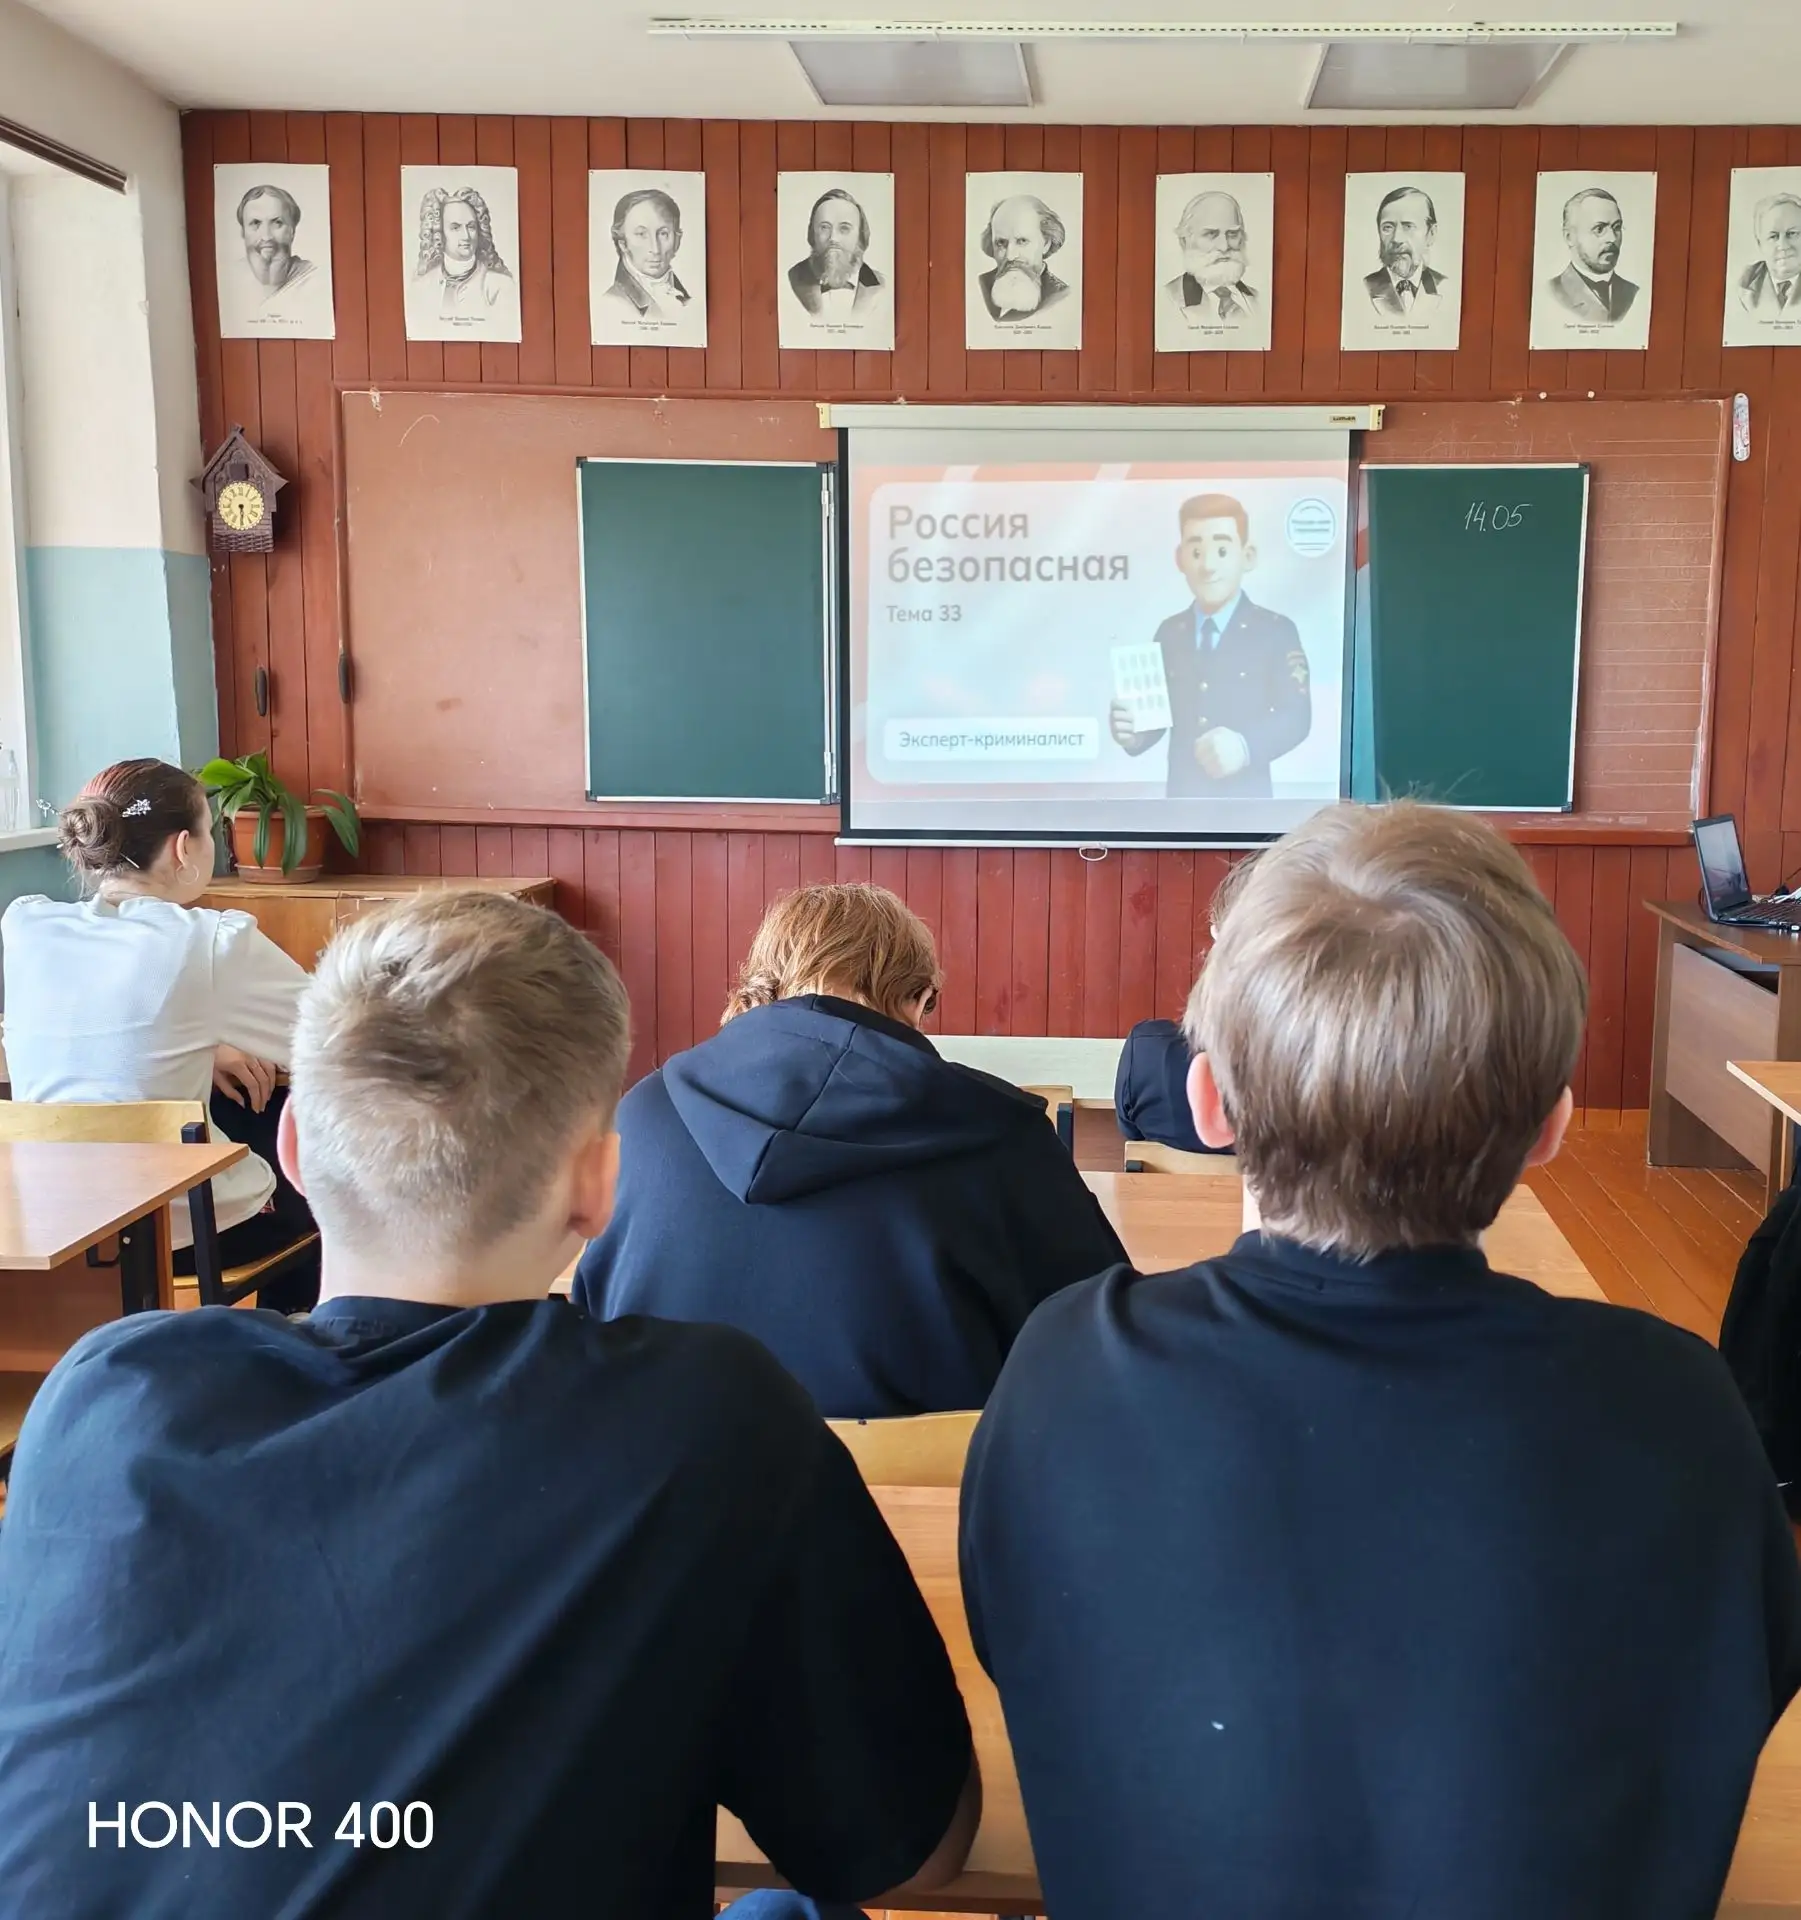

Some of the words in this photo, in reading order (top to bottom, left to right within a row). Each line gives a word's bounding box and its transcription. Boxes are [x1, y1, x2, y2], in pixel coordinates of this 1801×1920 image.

[889, 505, 1029, 540] Россия
[1464, 501, 1533, 532] 14.05
[887, 547, 1130, 582] безопасная
[886, 605, 933, 623] Тема
[939, 604, 962, 622] 33
[898, 732, 1085, 750] Эксперт-криминалист
